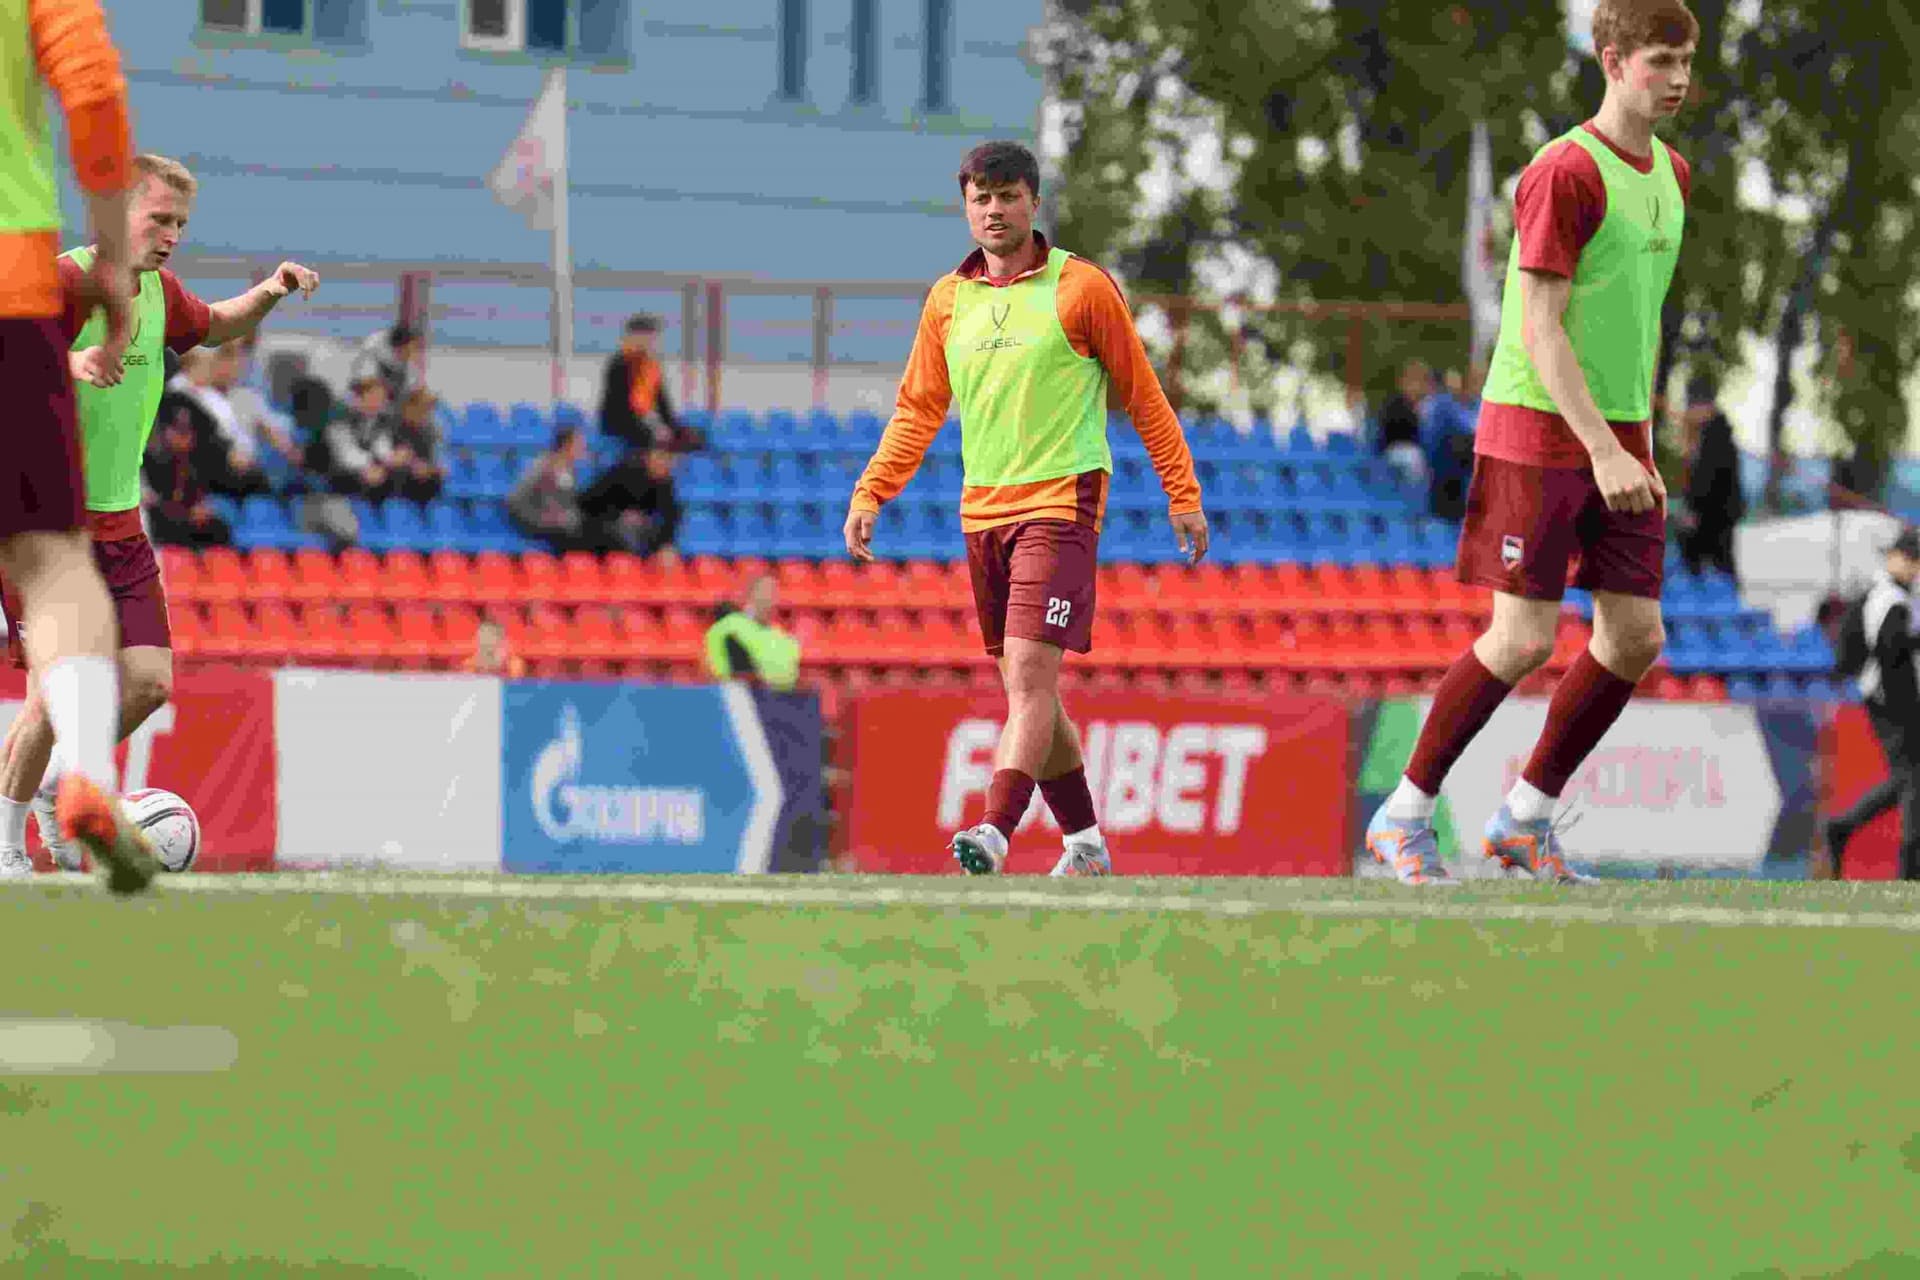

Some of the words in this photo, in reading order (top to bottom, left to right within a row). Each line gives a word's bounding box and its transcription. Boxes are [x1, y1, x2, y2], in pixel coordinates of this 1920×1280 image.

[121, 354, 150, 366] OGEL
[1045, 596, 1072, 628] 22
[937, 718, 1267, 836] FBET
